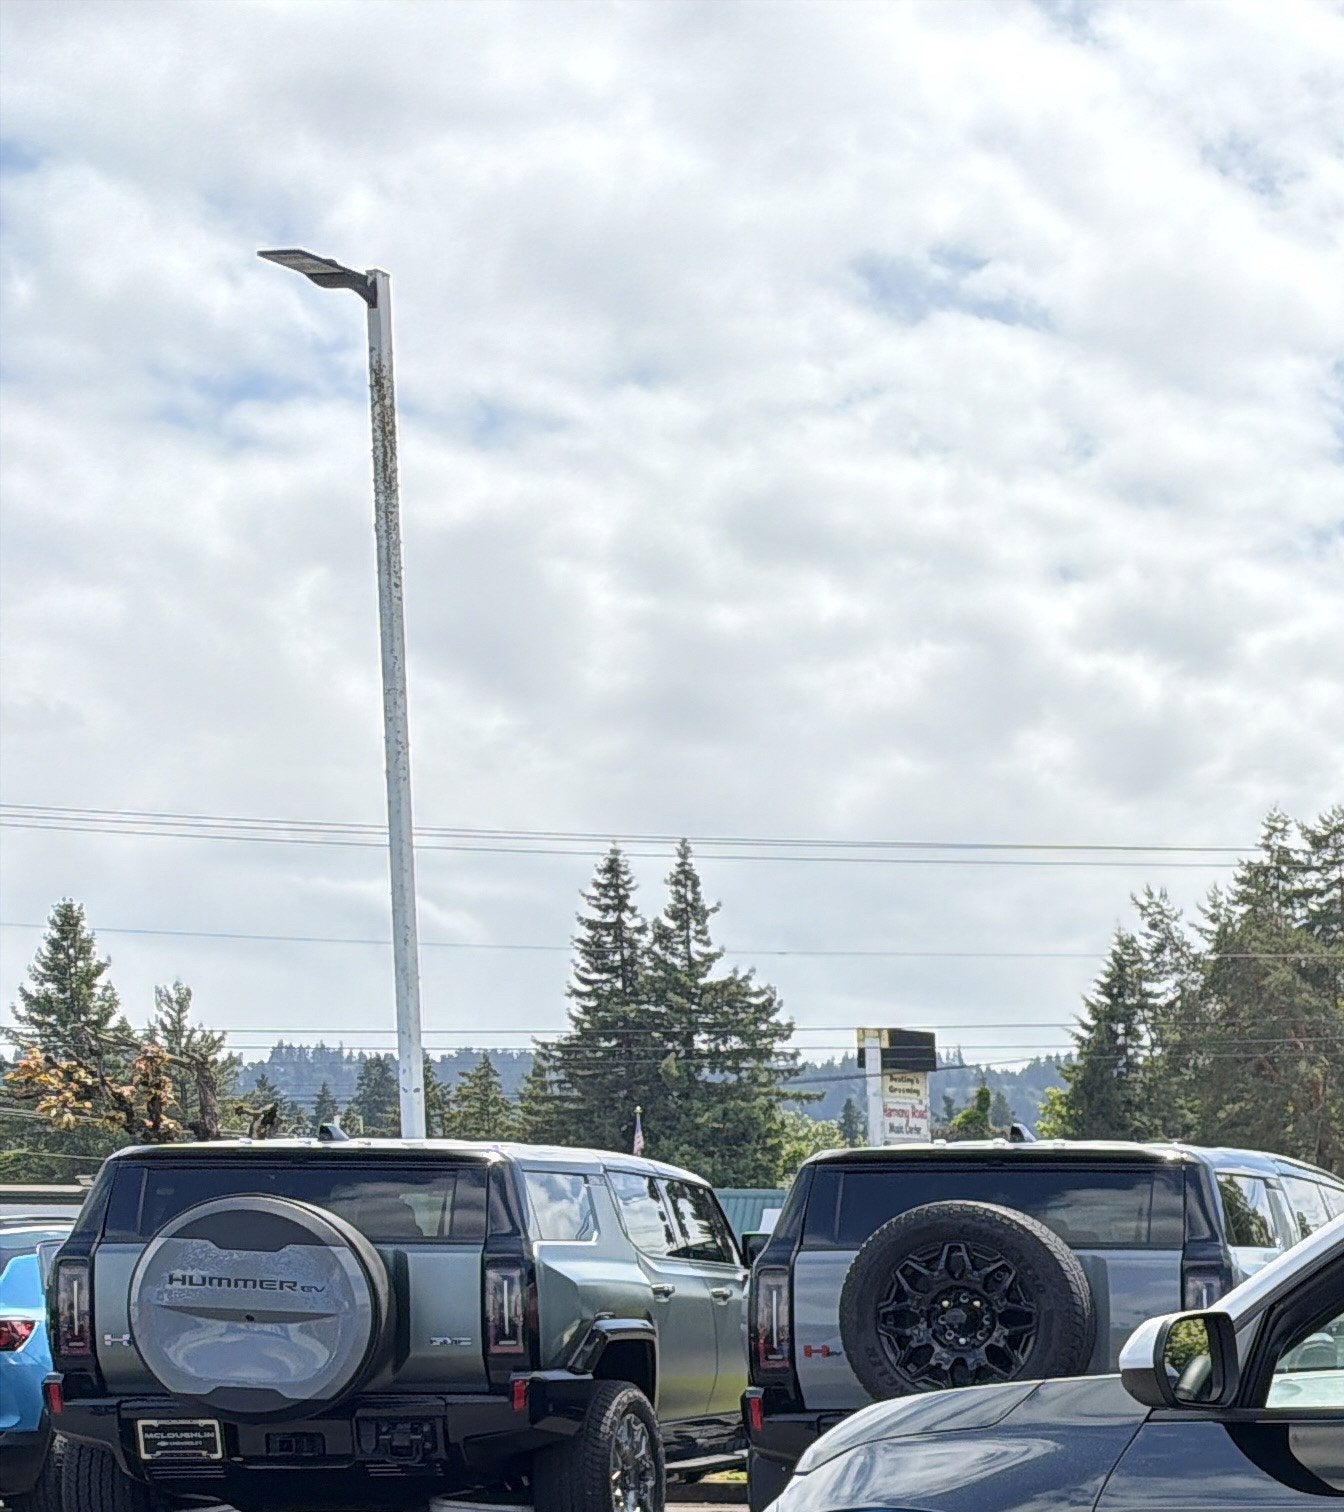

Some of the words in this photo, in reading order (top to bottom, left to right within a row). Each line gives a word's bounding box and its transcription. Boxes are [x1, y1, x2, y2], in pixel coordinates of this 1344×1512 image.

[911, 1104, 928, 1120] Road
[168, 1274, 298, 1292] HUMMER
[300, 1285, 325, 1293] EV
